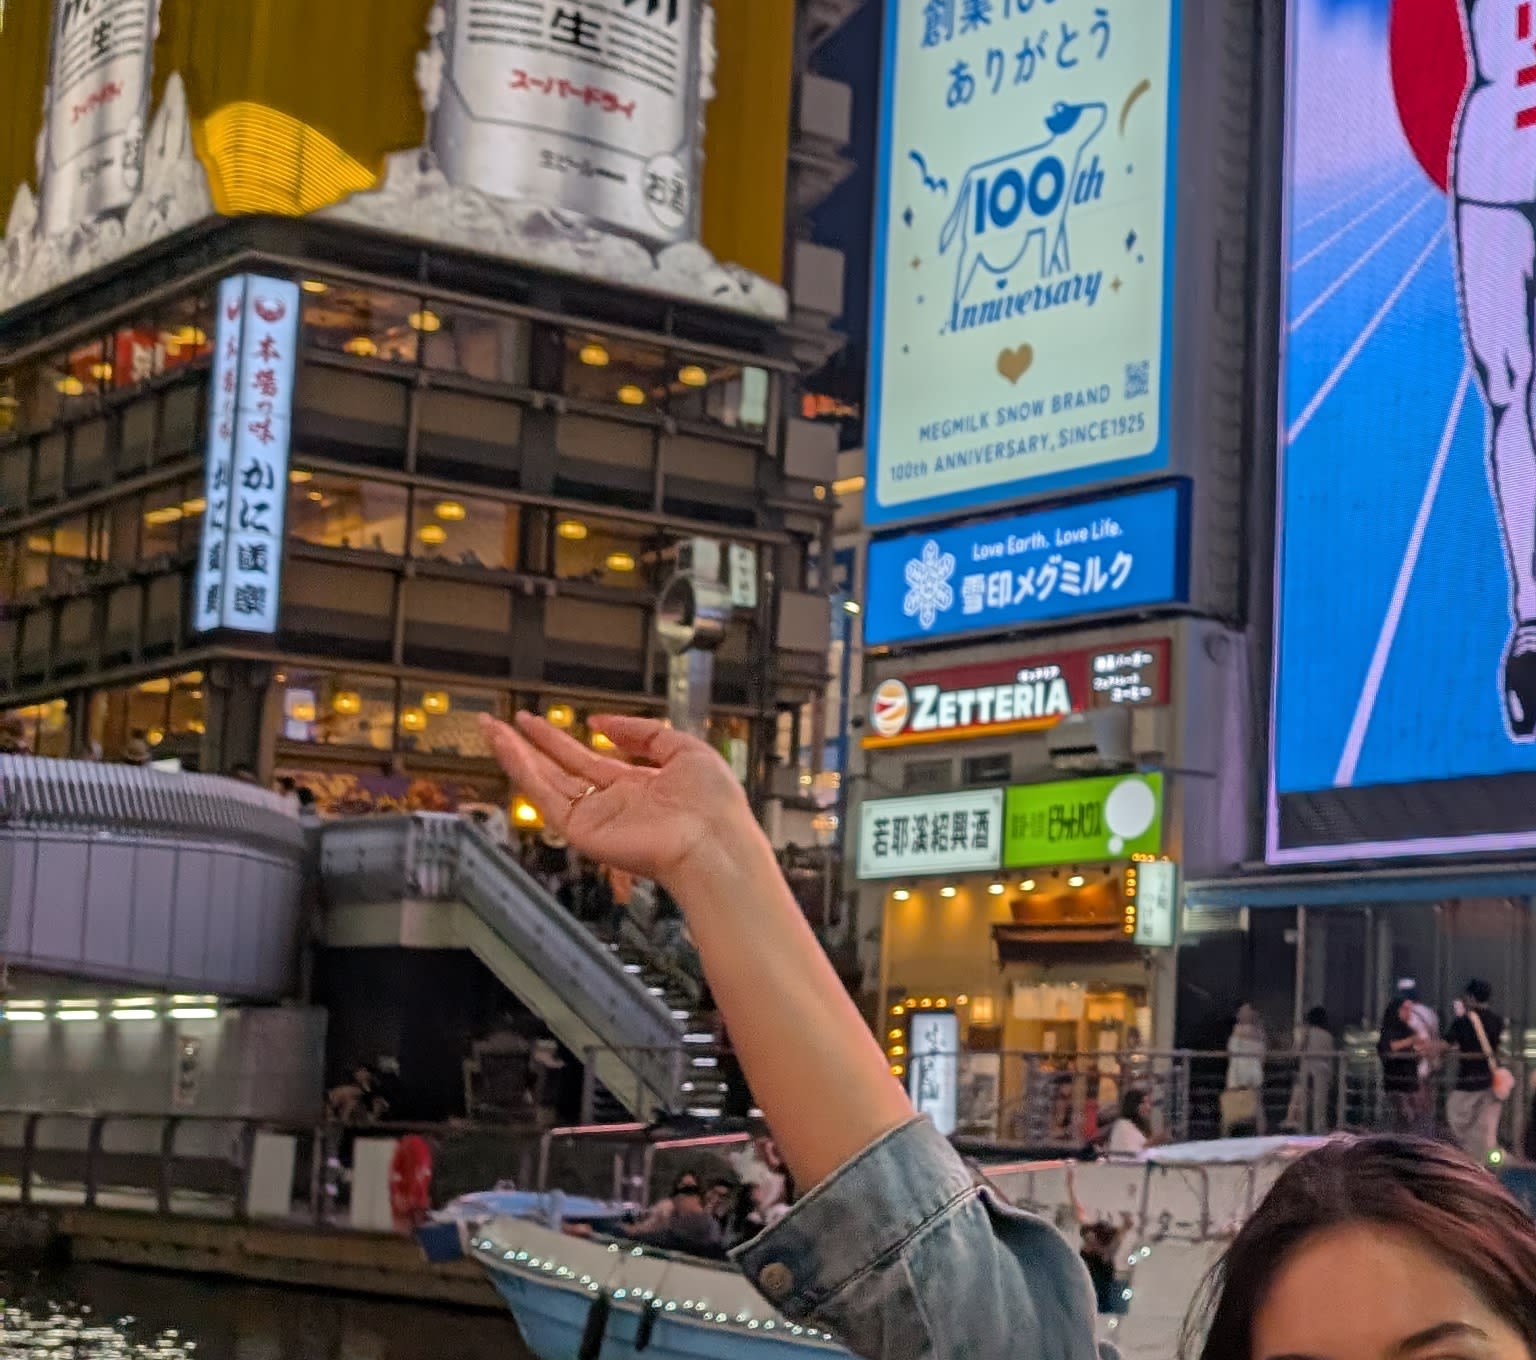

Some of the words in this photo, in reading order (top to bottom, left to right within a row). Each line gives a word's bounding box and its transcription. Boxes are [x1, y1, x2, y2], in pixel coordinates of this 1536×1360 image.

[551, 7, 602, 52] 生
[945, 6, 1113, 109] ありがとう
[974, 154, 1106, 235] 100th
[940, 269, 1104, 336] Anniversary
[919, 411, 990, 443] MEGMILK
[995, 399, 1045, 426] SNOW
[1050, 384, 1111, 414] BRAND
[889, 460, 928, 482] 100th
[972, 542, 1004, 561] Love
[1055, 528, 1088, 548] Love
[961, 551, 1134, 615] 雪印メグミルク
[911, 676, 1072, 731] ZETTERIA
